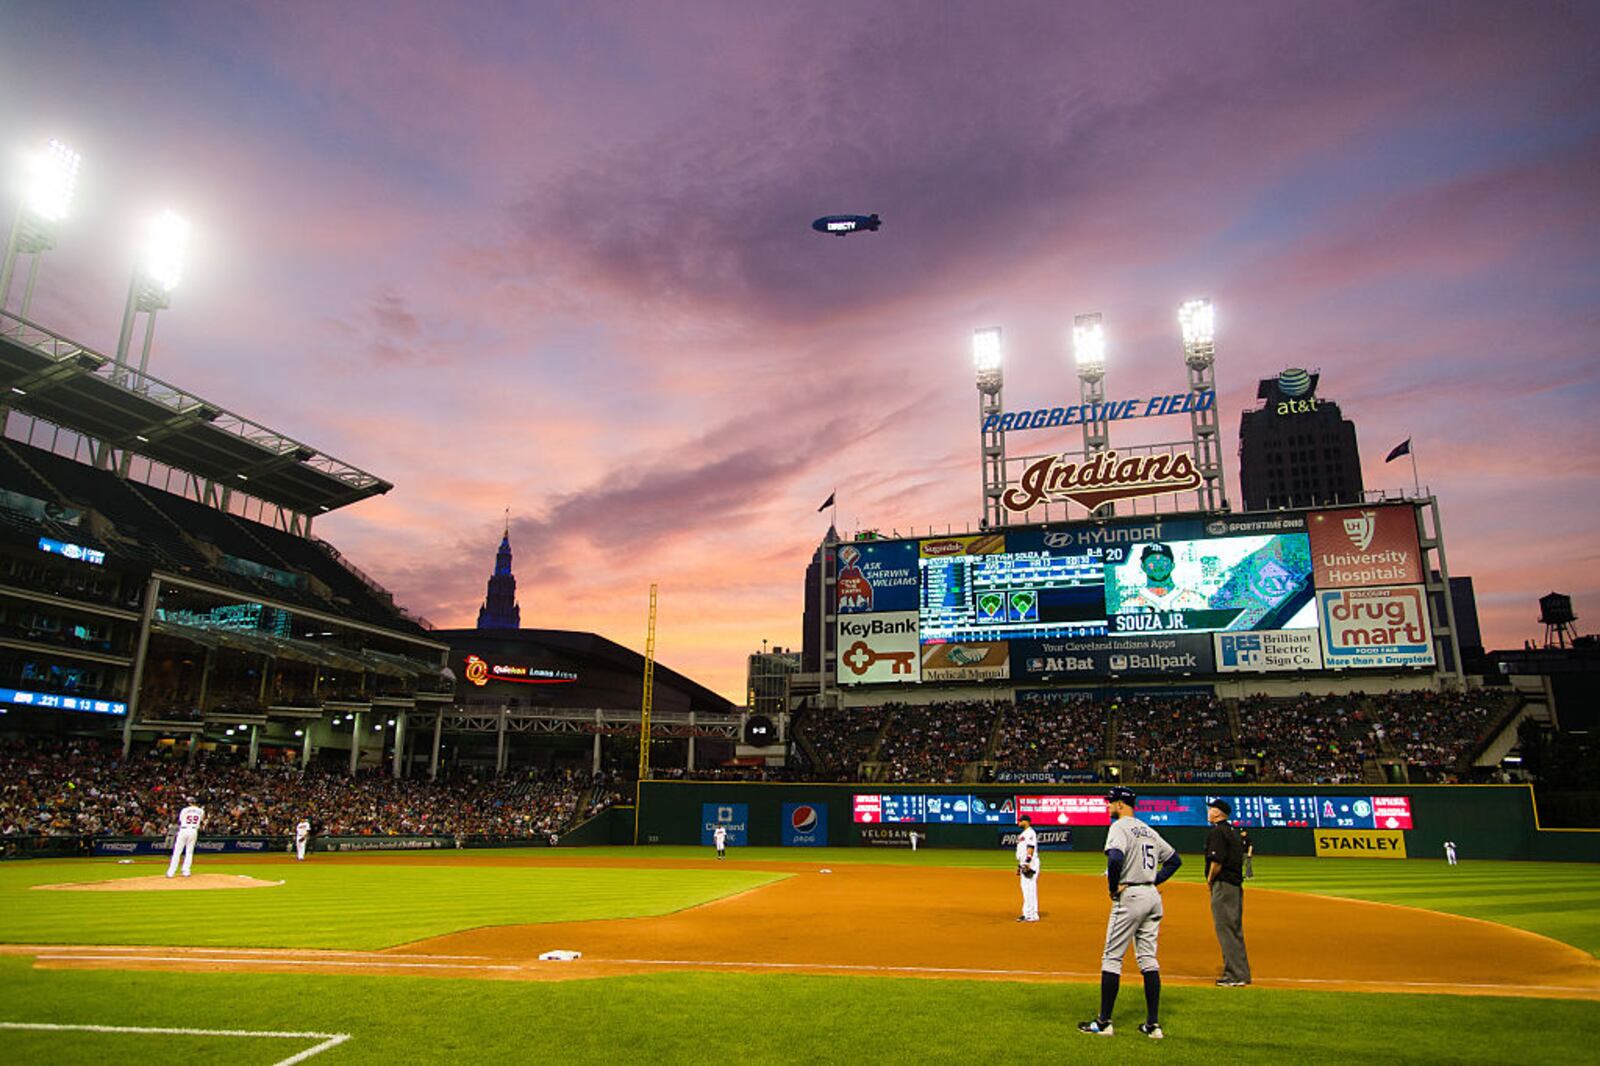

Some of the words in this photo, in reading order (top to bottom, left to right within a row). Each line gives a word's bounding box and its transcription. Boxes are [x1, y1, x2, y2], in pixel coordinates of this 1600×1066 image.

[981, 399, 1140, 433] PROGRESSIVE
[1144, 389, 1216, 417] FIELD
[1276, 396, 1318, 415] at&t
[1000, 450, 1203, 514] Indians
[1229, 520, 1282, 532] SPORTSTIME
[1282, 518, 1304, 528] OHIO
[1078, 523, 1162, 545] HYUNDAI
[1105, 547, 1123, 561] 20
[1322, 549, 1407, 567] University
[863, 562, 882, 571] ASK
[866, 569, 910, 580] SHERWIN
[1328, 566, 1407, 584] Hospitals
[872, 577, 918, 588] WILLIAMS
[1350, 590, 1391, 599] DISCOUNT
[1333, 598, 1405, 625] drug
[840, 618, 917, 638] KeyBank
[1116, 613, 1163, 631] SOUZA
[1165, 613, 1189, 630] JR.
[1263, 634, 1312, 644] Brilliant
[1342, 622, 1426, 646] mart
[1042, 643, 1064, 653] Your
[1065, 640, 1112, 651] Cleveland
[1113, 639, 1149, 650] Indians
[1151, 638, 1177, 649] Apps
[1264, 645, 1311, 655] Electric
[1355, 647, 1379, 655] FOOD
[1044, 658, 1064, 672] At
[1066, 657, 1095, 671] Bat
[1129, 653, 1198, 671] Ballpark
[1266, 655, 1292, 667] Sign
[1293, 654, 1314, 665] Co.
[1326, 658, 1350, 666] More
[1353, 656, 1375, 666] than
[1385, 655, 1433, 665] Drugstore
[493, 665, 527, 676] Quicken
[529, 667, 554, 678] Loans
[555, 669, 578, 680] Arena
[927, 670, 967, 680] Medical
[968, 668, 1004, 680] Mutual
[1042, 692, 1093, 704] HYUNDAI
[1014, 772, 1054, 781] HYUNDAI
[1195, 770, 1232, 779] HYUNDAI
[186, 815, 200, 825] 59
[792, 835, 817, 844] pepsi
[1319, 836, 1401, 852] STANLEY
[1141, 843, 1156, 870] 15
